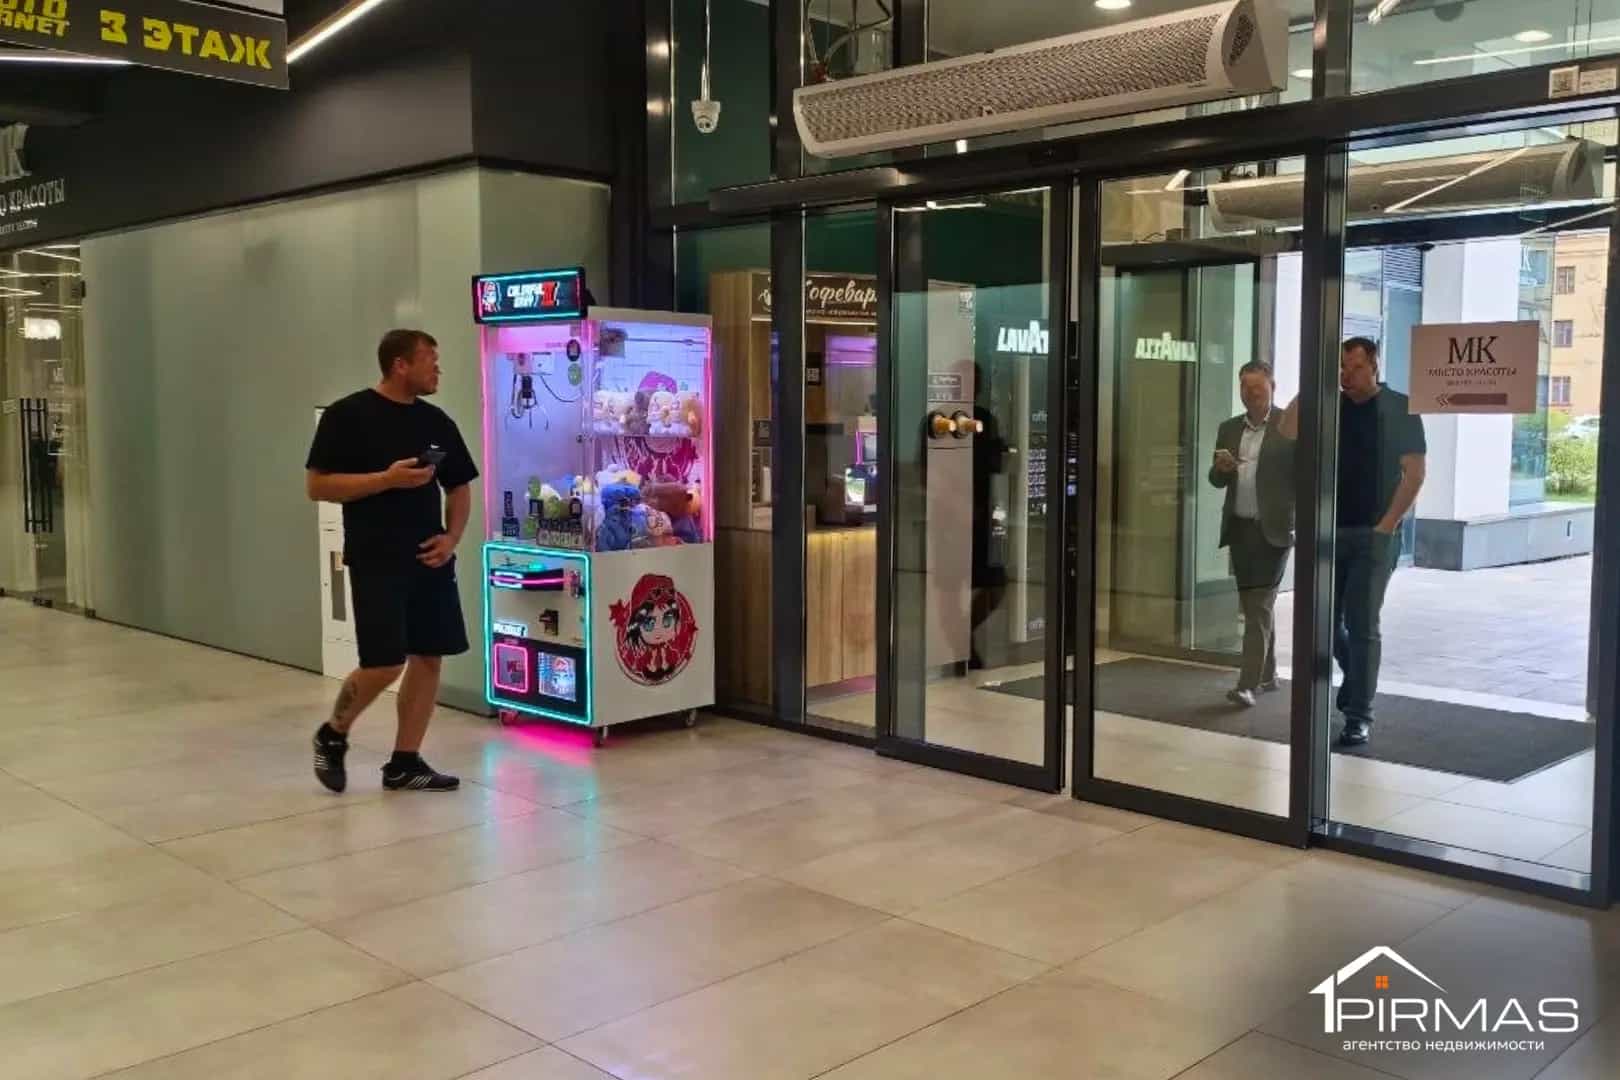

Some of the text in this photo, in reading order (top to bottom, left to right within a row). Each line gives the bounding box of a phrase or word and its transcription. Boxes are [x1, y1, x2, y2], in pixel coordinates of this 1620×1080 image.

[100, 10, 272, 69] 3 ЭТАЖ
[1448, 335, 1498, 364] МК
